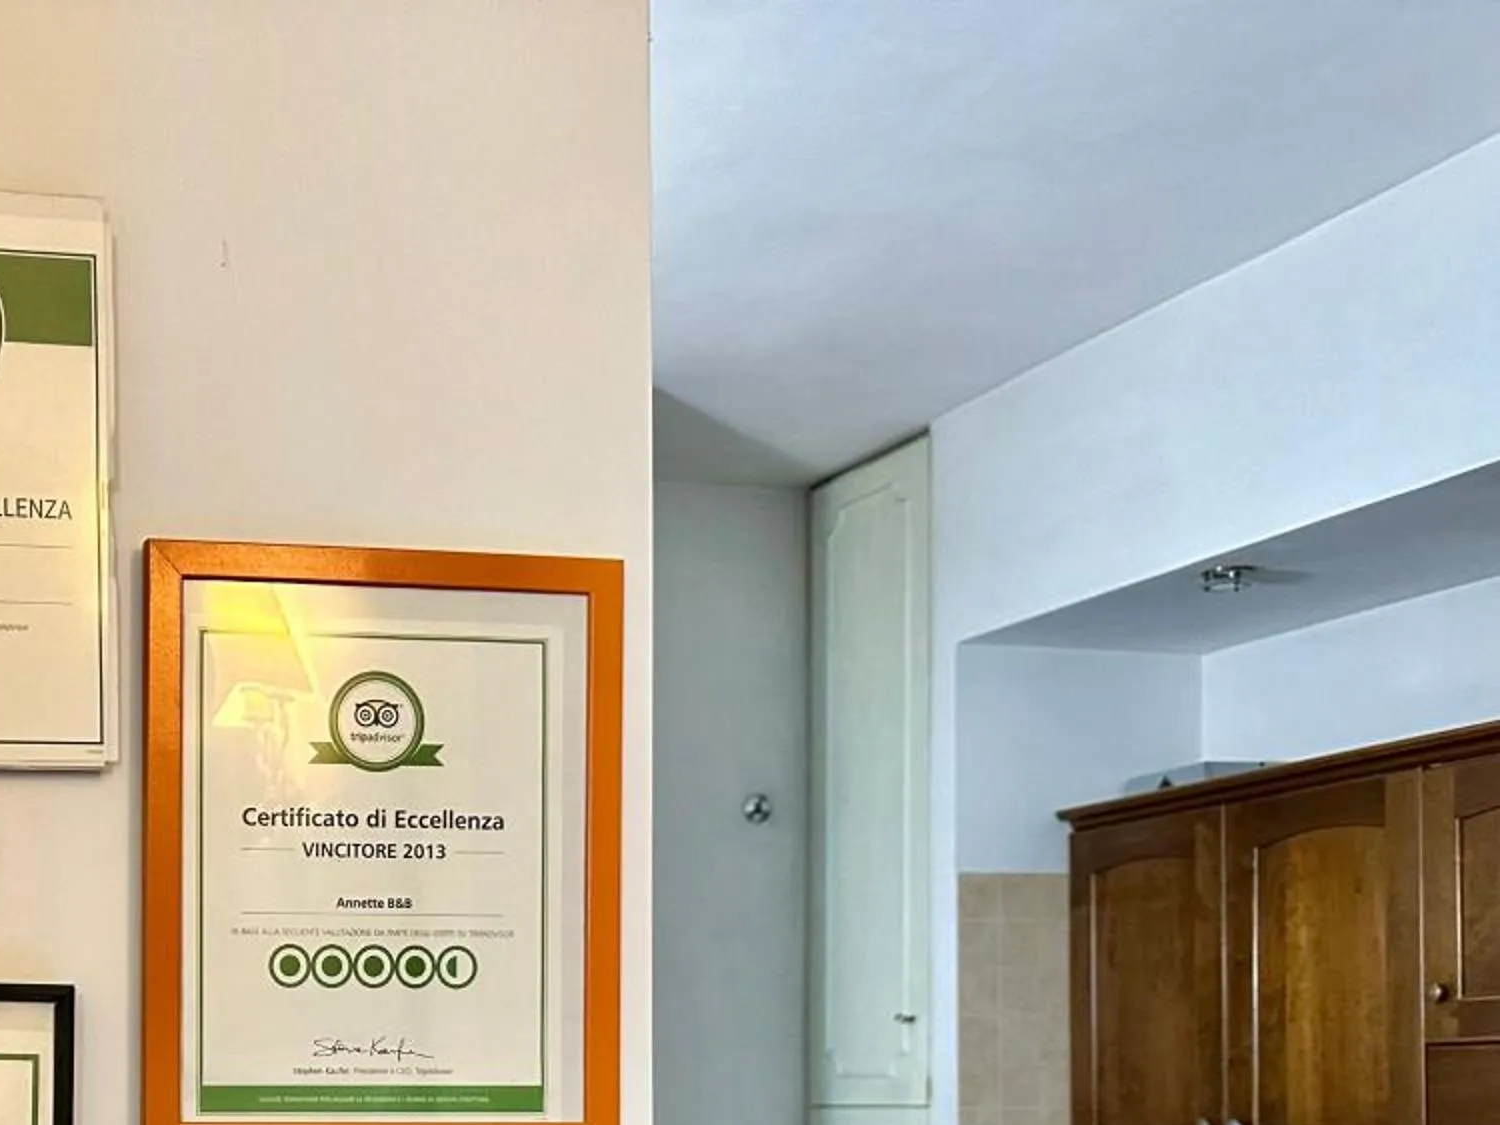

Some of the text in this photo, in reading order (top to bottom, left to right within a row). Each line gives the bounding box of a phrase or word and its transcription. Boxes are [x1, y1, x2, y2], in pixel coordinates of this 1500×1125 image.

[242, 806, 505, 831] Certificato di Eccellenza
[301, 842, 446, 860] VINCITORE 2013
[336, 897, 384, 910] Annette
